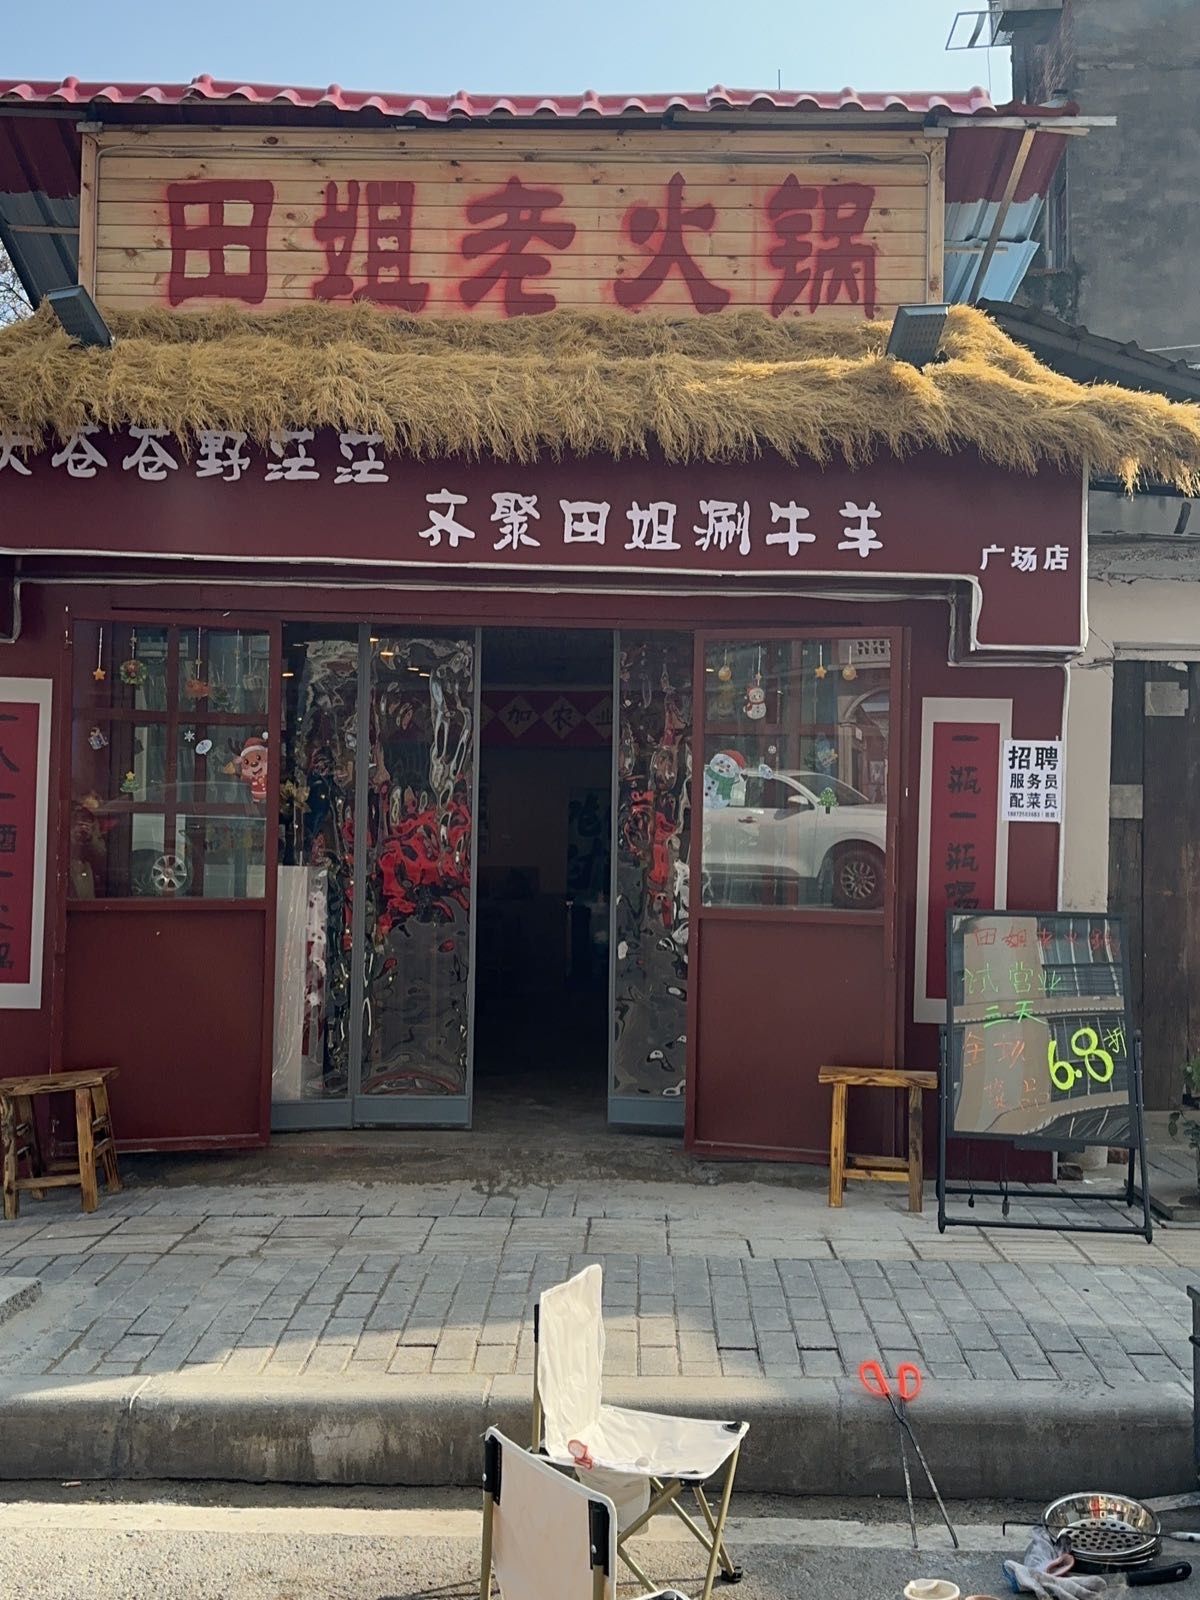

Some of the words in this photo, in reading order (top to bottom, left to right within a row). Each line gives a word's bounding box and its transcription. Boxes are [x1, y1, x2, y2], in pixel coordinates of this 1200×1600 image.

[167, 171, 876, 318] 田姐老火锅
[418, 488, 883, 558] 齐聚田姐涮牛羊
[980, 544, 1069, 572] 广场店
[1008, 746, 1058, 771] 招聘
[1010, 773, 1058, 790] 服务员
[1009, 792, 1058, 810] 配菜员
[962, 962, 1071, 994] 试营业
[983, 1000, 1048, 1029] 三天
